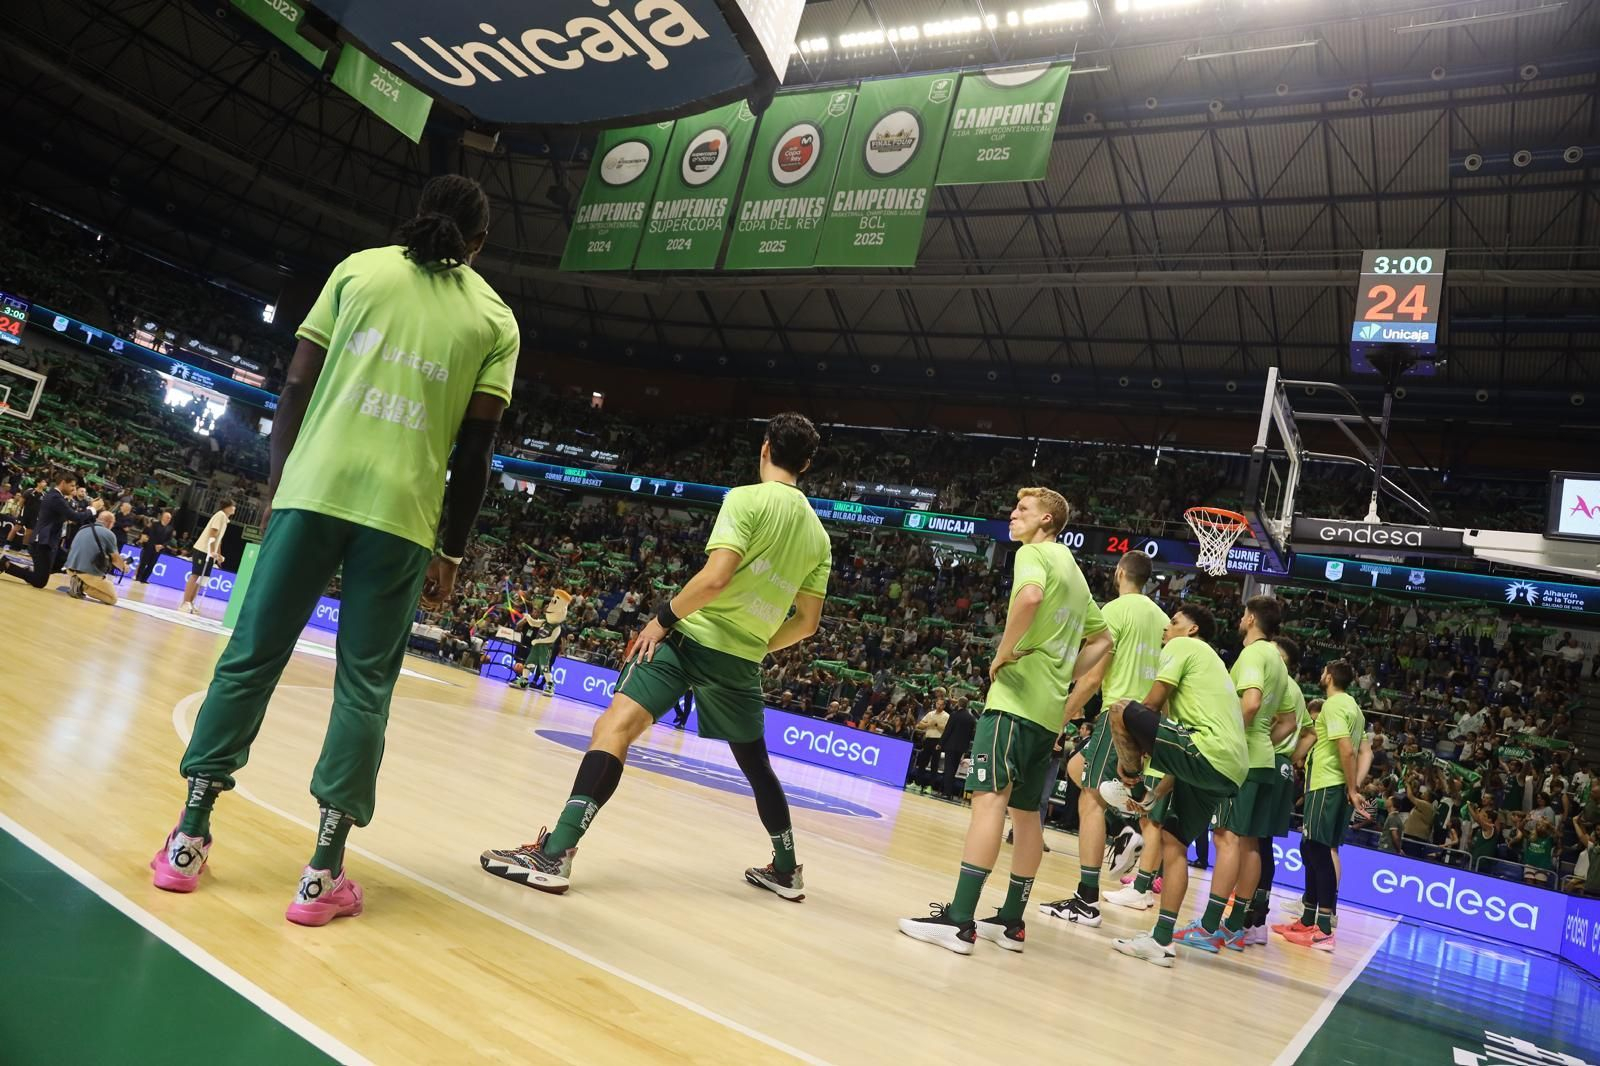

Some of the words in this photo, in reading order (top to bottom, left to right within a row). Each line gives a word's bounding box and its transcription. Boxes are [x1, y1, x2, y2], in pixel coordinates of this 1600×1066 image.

[391, 0, 710, 87] Unicaja
[370, 73, 401, 102] 2024
[953, 102, 1056, 130] CAMPEONES
[974, 125, 1050, 136] INTERCONTINENTAL
[976, 147, 1011, 161] 2025
[833, 188, 927, 211] CAMPEONES
[577, 202, 646, 224] CAMPEONES
[652, 198, 729, 220] CAMPEONES
[740, 197, 826, 221] CAMPEONES
[649, 217, 722, 234] SUPERCOPA
[738, 220, 766, 232] COPA
[770, 218, 791, 231] DEL
[796, 217, 820, 230] REY
[859, 216, 886, 229] BCL
[587, 240, 612, 252] 2024
[666, 238, 692, 251] 2024
[758, 240, 787, 253] 2025
[853, 232, 885, 246] 2025
[1373, 256, 1433, 275] 3:00
[1364, 284, 1429, 321] 24
[4, 306, 26, 320] 3:00
[0, 316, 20, 336] 24
[1382, 328, 1429, 343] Unicaja
[381, 342, 449, 383] Unicaja
[563, 474, 581, 484] BILBAO
[581, 477, 603, 487] BASKET
[834, 502, 863, 513] UNICAJA
[815, 508, 833, 518] URNE
[832, 511, 857, 521] BILBAO
[856, 514, 885, 525] BASKET
[928, 517, 975, 534] UNICAJA
[1320, 524, 1422, 546] endesa
[1107, 536, 1129, 553] 24
[1144, 540, 1159, 558] 0
[1228, 549, 1260, 562] SURNE
[1227, 560, 1259, 572] BASKET
[1543, 589, 1578, 599] Alhaurín
[1563, 597, 1585, 606] Torre
[783, 726, 880, 767] endesa
[188, 777, 210, 807] UNICAJ
[318, 809, 342, 846] UNICAJA
[1371, 868, 1539, 932] endesa
